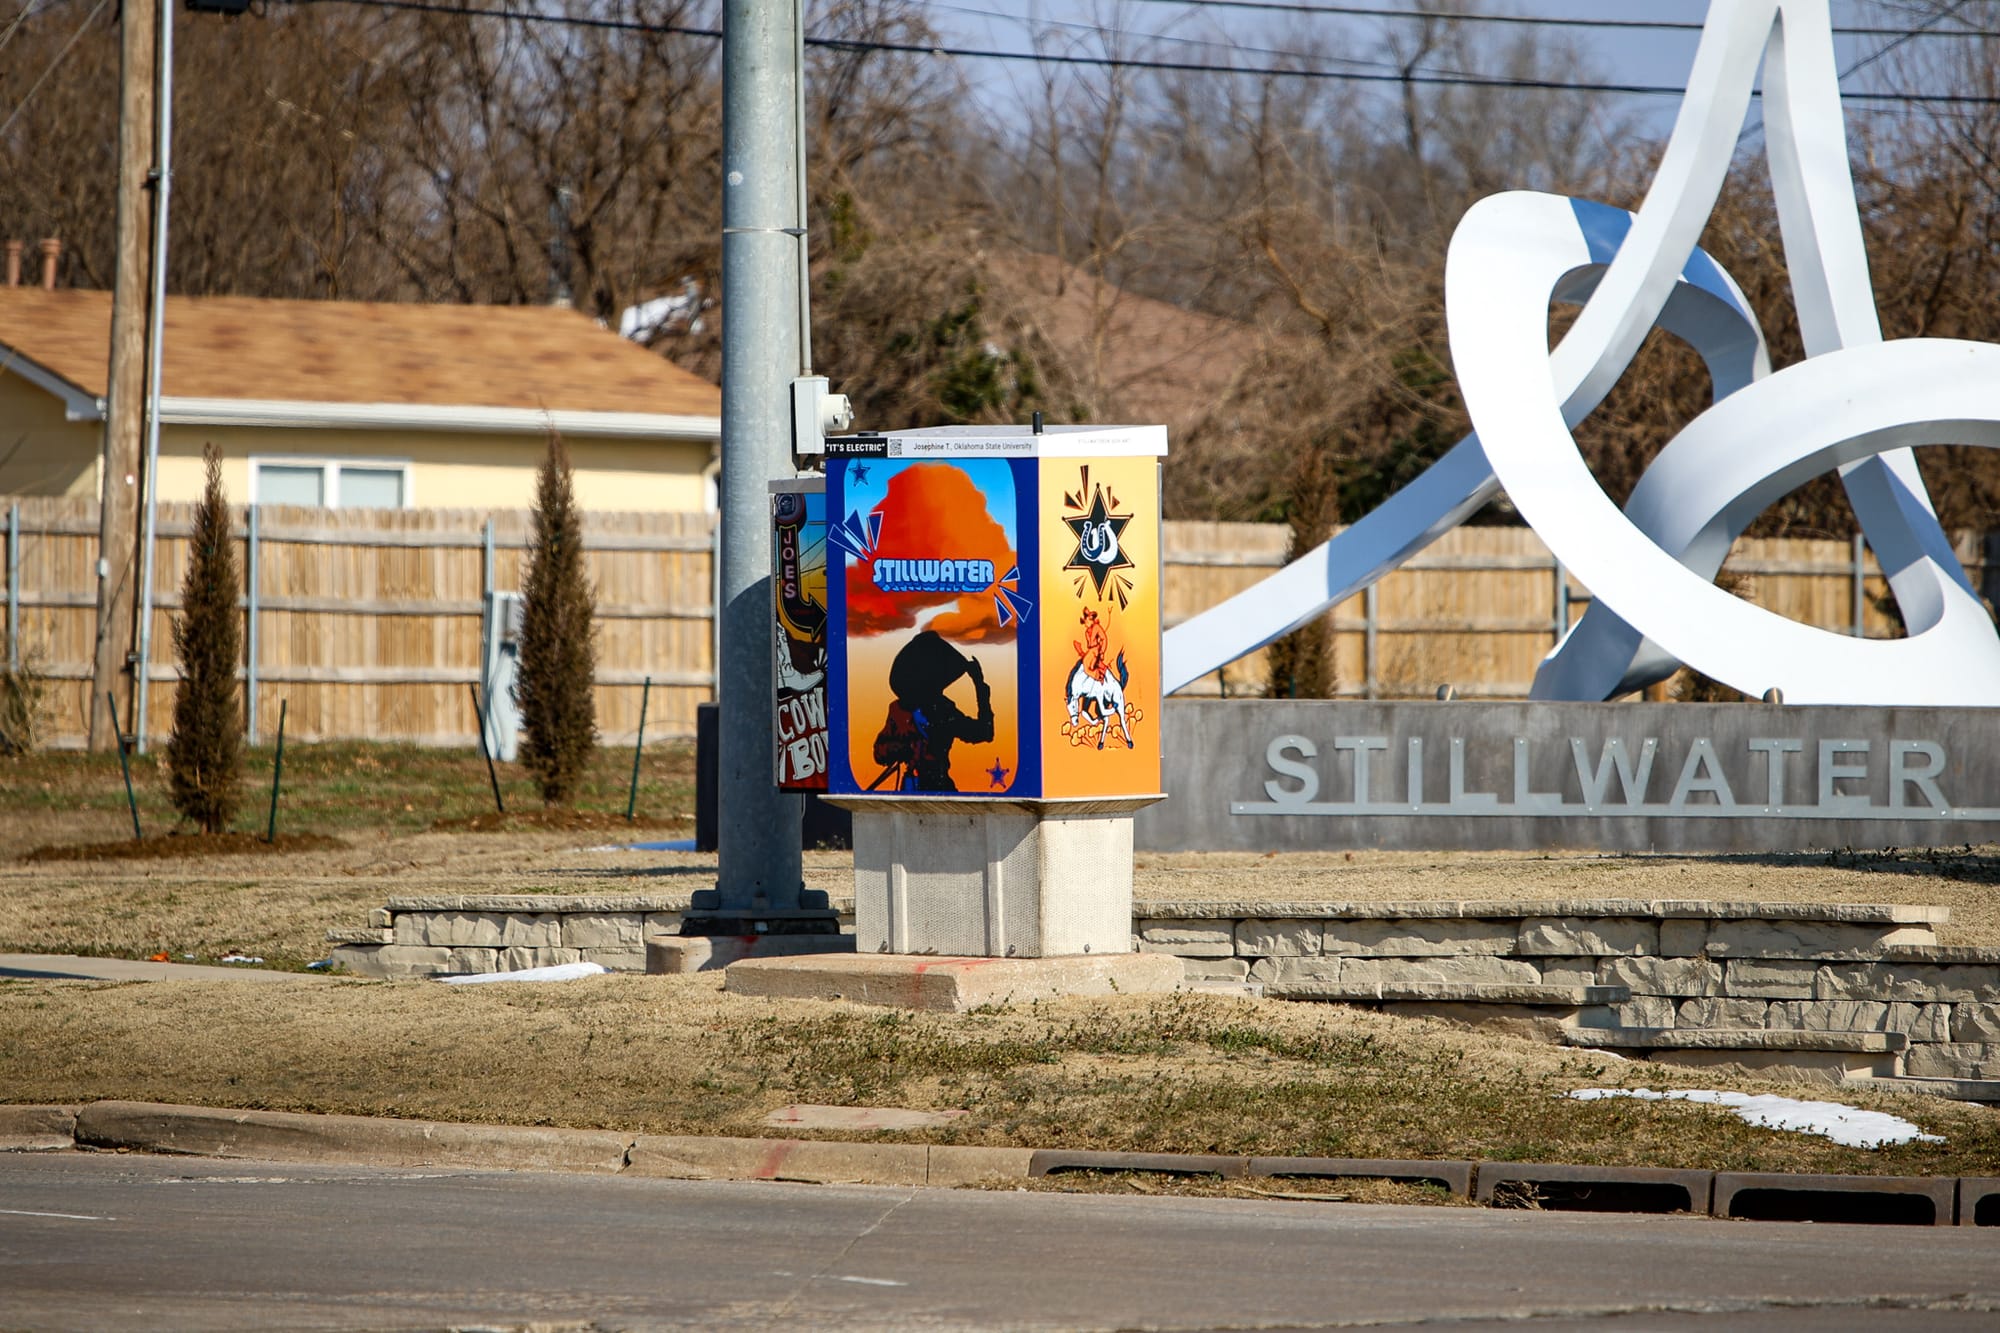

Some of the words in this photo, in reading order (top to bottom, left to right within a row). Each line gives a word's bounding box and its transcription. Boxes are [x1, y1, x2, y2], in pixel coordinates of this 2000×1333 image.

[846, 443, 885, 452] ELECTRIC"
[913, 442, 945, 452] Josephine
[954, 442, 984, 451] Oklahoma
[985, 442, 1001, 451] State
[1002, 442, 1032, 451] University
[872, 558, 995, 586] STILLWATER
[778, 687, 826, 742] COW
[1263, 735, 1951, 815] STILLWATER
